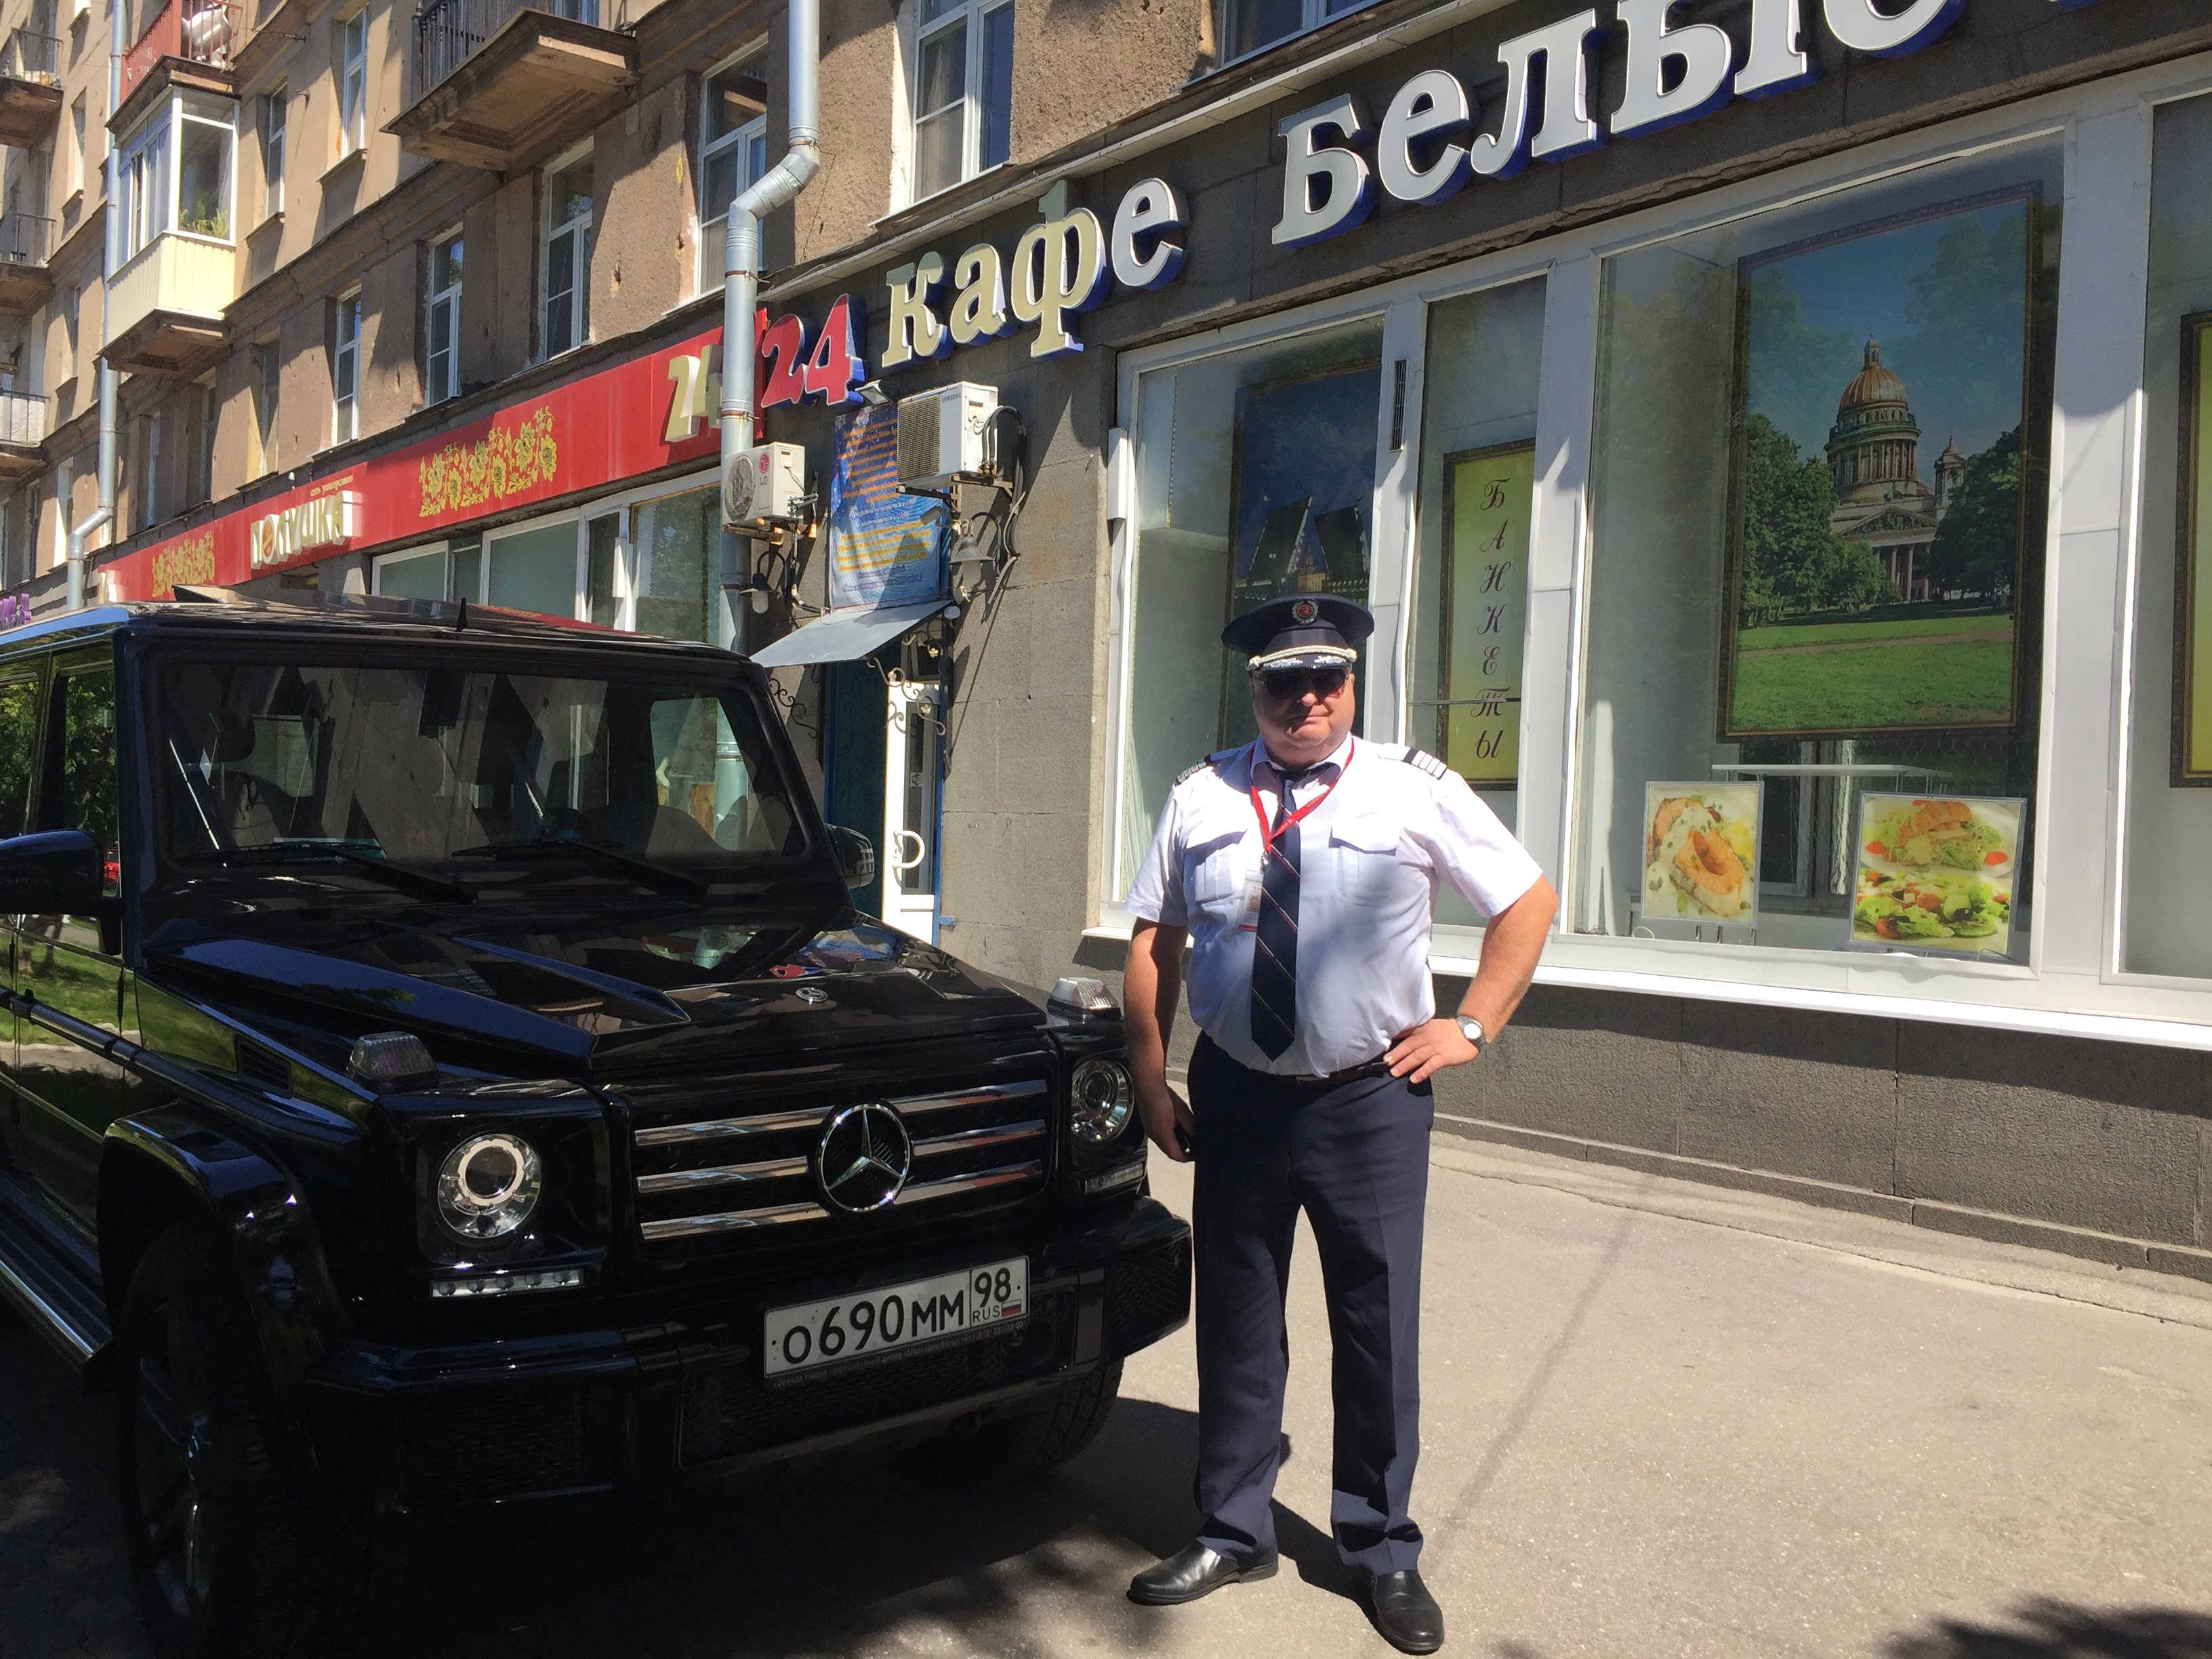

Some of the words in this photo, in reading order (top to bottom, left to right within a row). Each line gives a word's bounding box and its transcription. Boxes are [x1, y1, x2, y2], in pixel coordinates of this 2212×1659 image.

[882, 178, 1185, 368] кафе
[760, 293, 858, 408] 24
[760, 476, 768, 486] LG
[974, 1267, 1012, 1308] 98
[972, 1302, 1001, 1322] RUS
